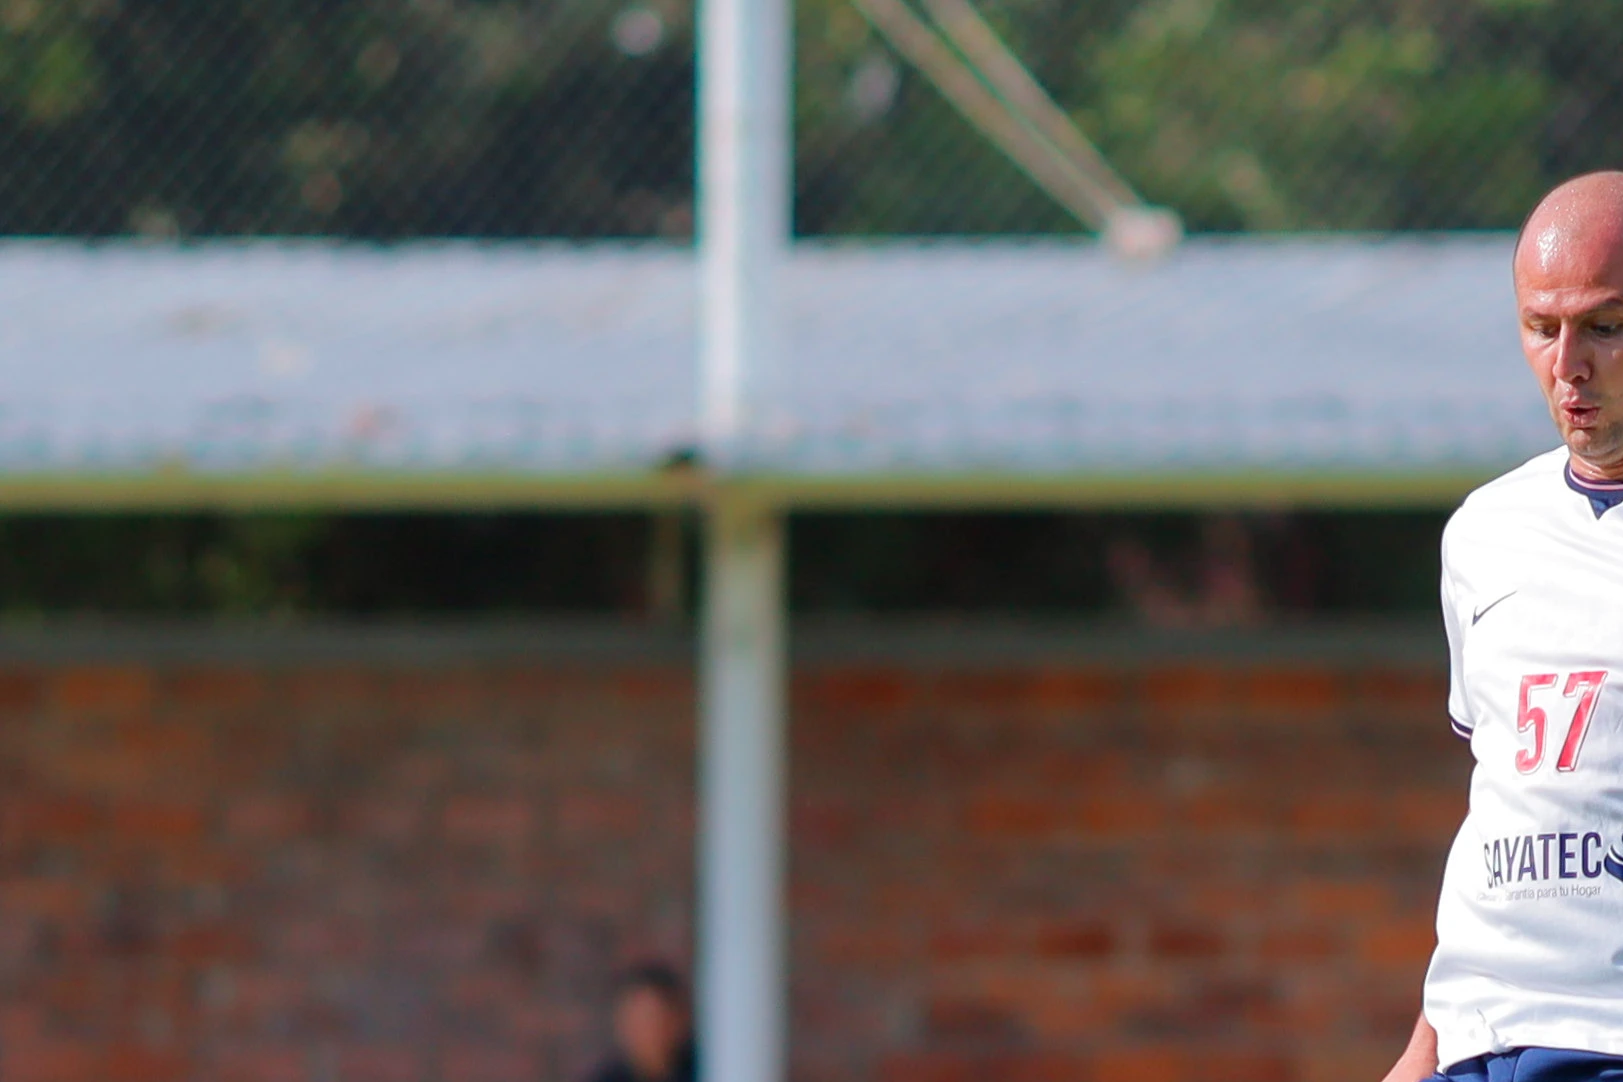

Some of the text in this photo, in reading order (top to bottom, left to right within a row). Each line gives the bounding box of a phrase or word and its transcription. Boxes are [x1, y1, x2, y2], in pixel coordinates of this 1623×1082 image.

[1515, 670, 1608, 775] 57
[1484, 831, 1602, 889] SAYATEC
[1537, 887, 1558, 901] para
[1559, 884, 1569, 897] tu
[1571, 883, 1601, 899] Hogar
